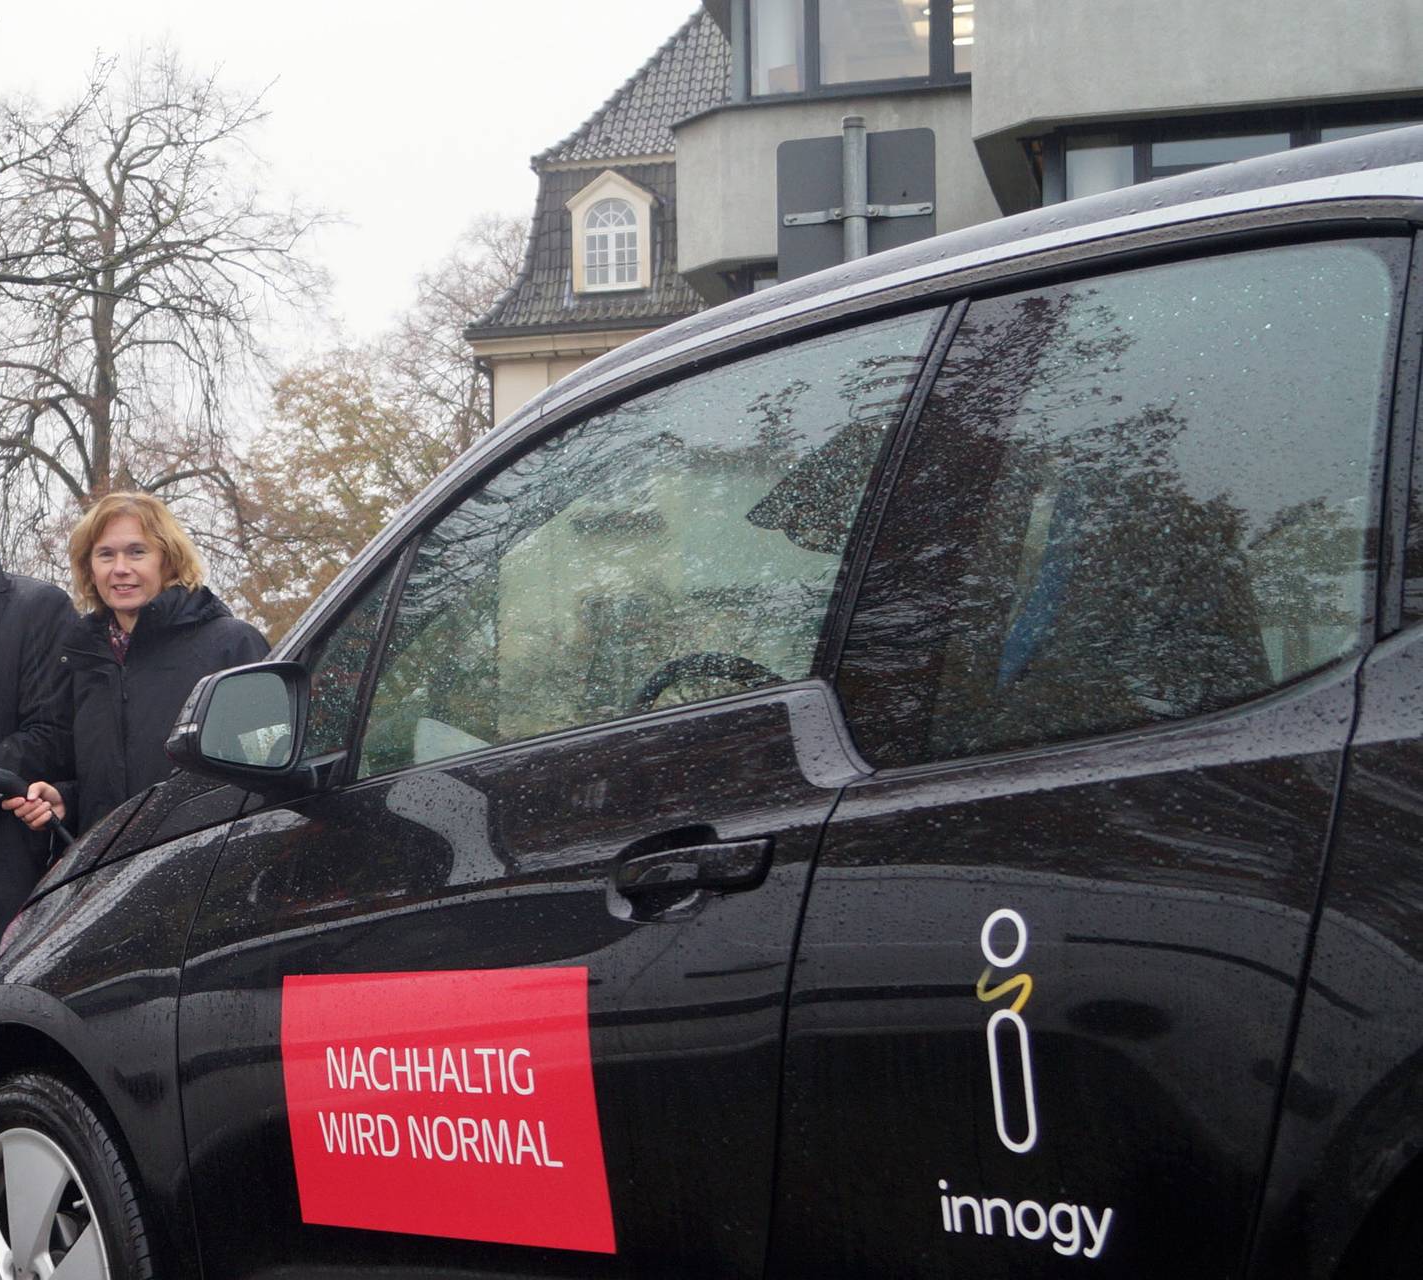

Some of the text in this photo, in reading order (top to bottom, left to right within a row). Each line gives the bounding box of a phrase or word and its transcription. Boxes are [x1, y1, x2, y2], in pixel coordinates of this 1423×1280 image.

[325, 1046, 536, 1096] NACHHALTIG
[318, 1111, 564, 1169] WIRD NORMAL
[937, 1178, 1114, 1260] innogy
